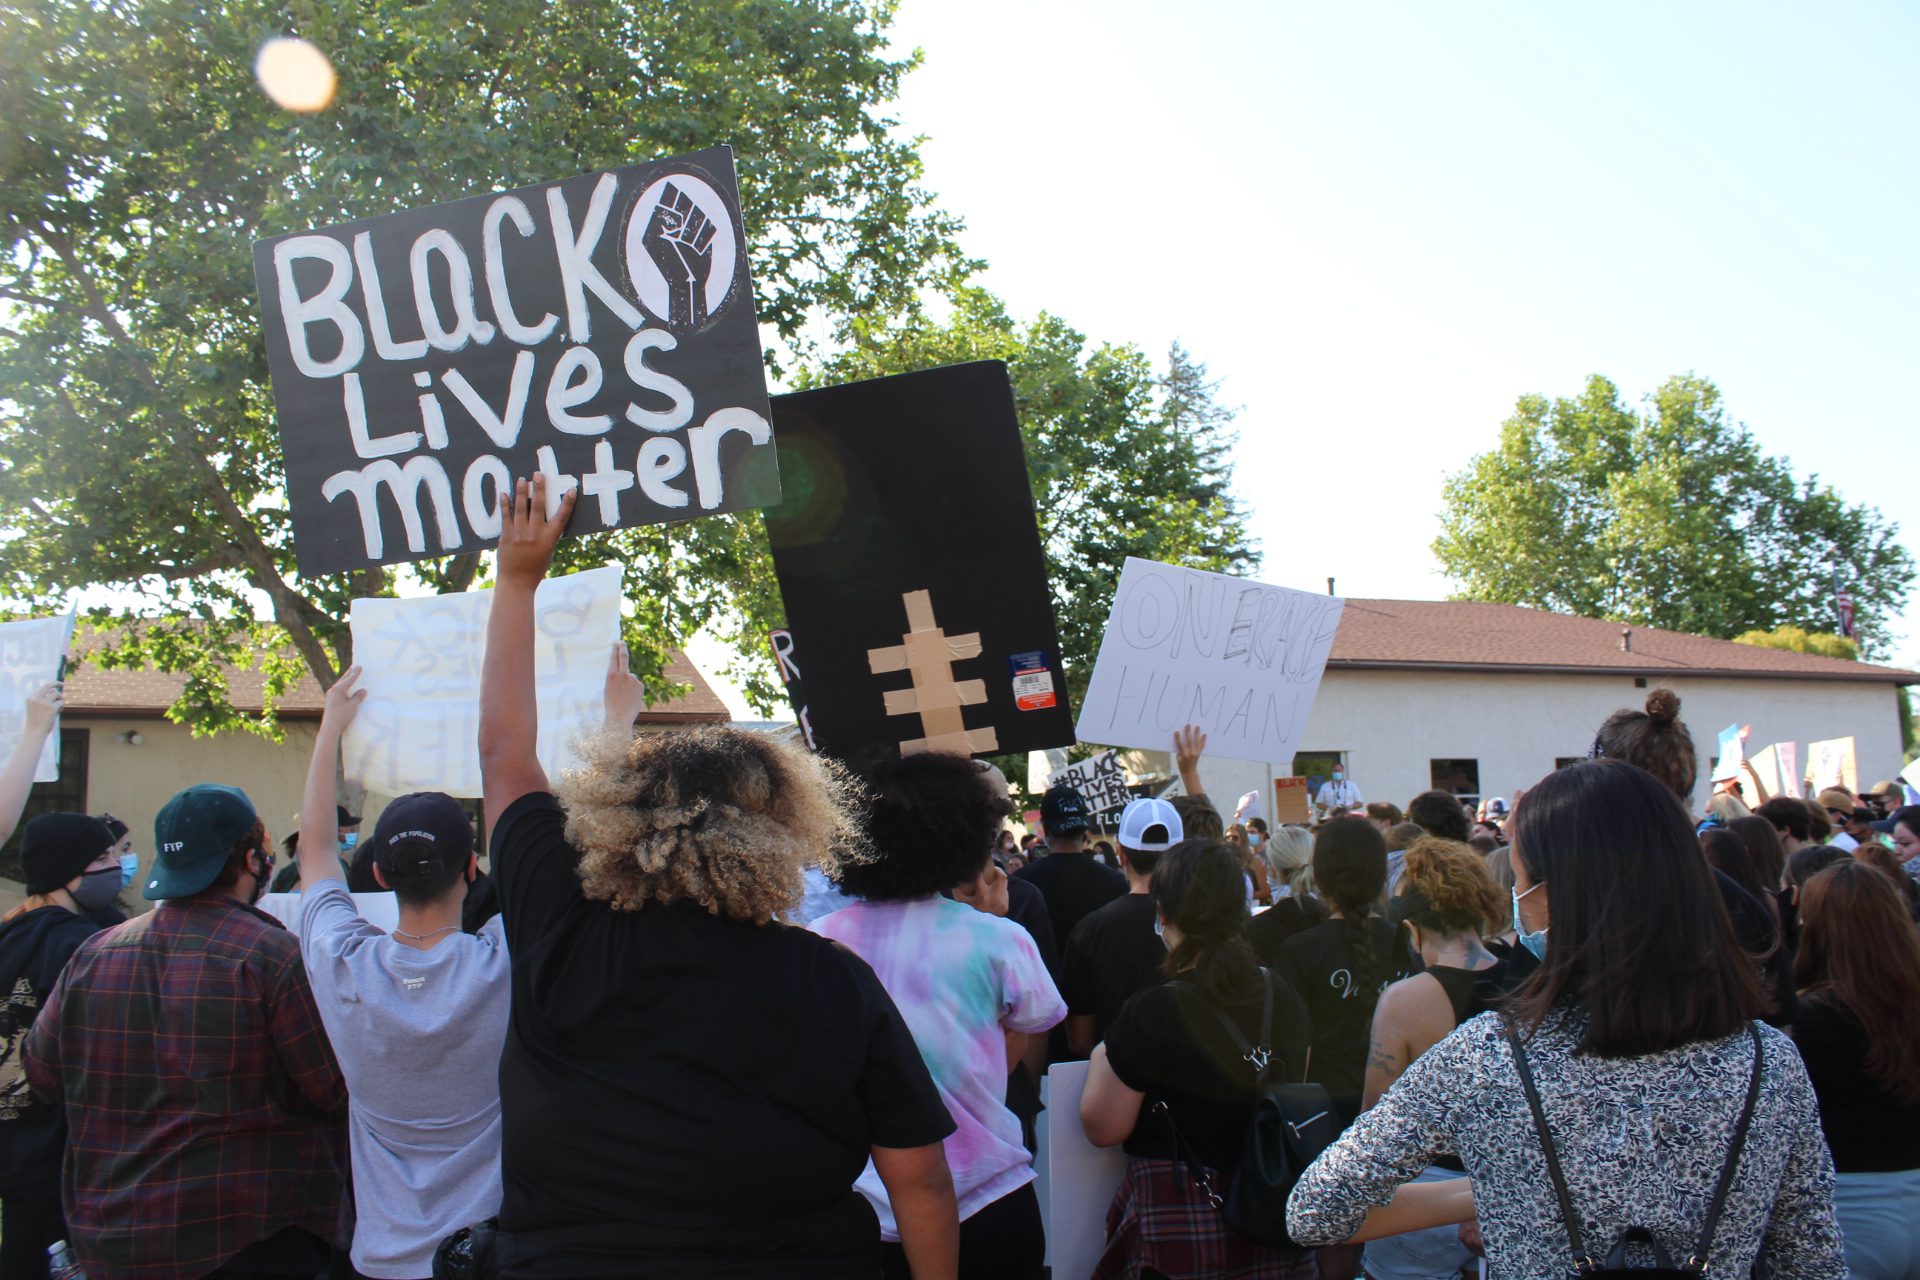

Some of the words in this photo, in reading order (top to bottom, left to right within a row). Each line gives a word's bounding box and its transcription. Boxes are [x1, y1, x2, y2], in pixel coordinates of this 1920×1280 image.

[1109, 665, 1300, 745] HUMAN
[1053, 751, 1128, 789] #BLACK
[1084, 772, 1122, 797] IVES
[1095, 811, 1122, 825] FLO
[163, 841, 184, 852] FTP
